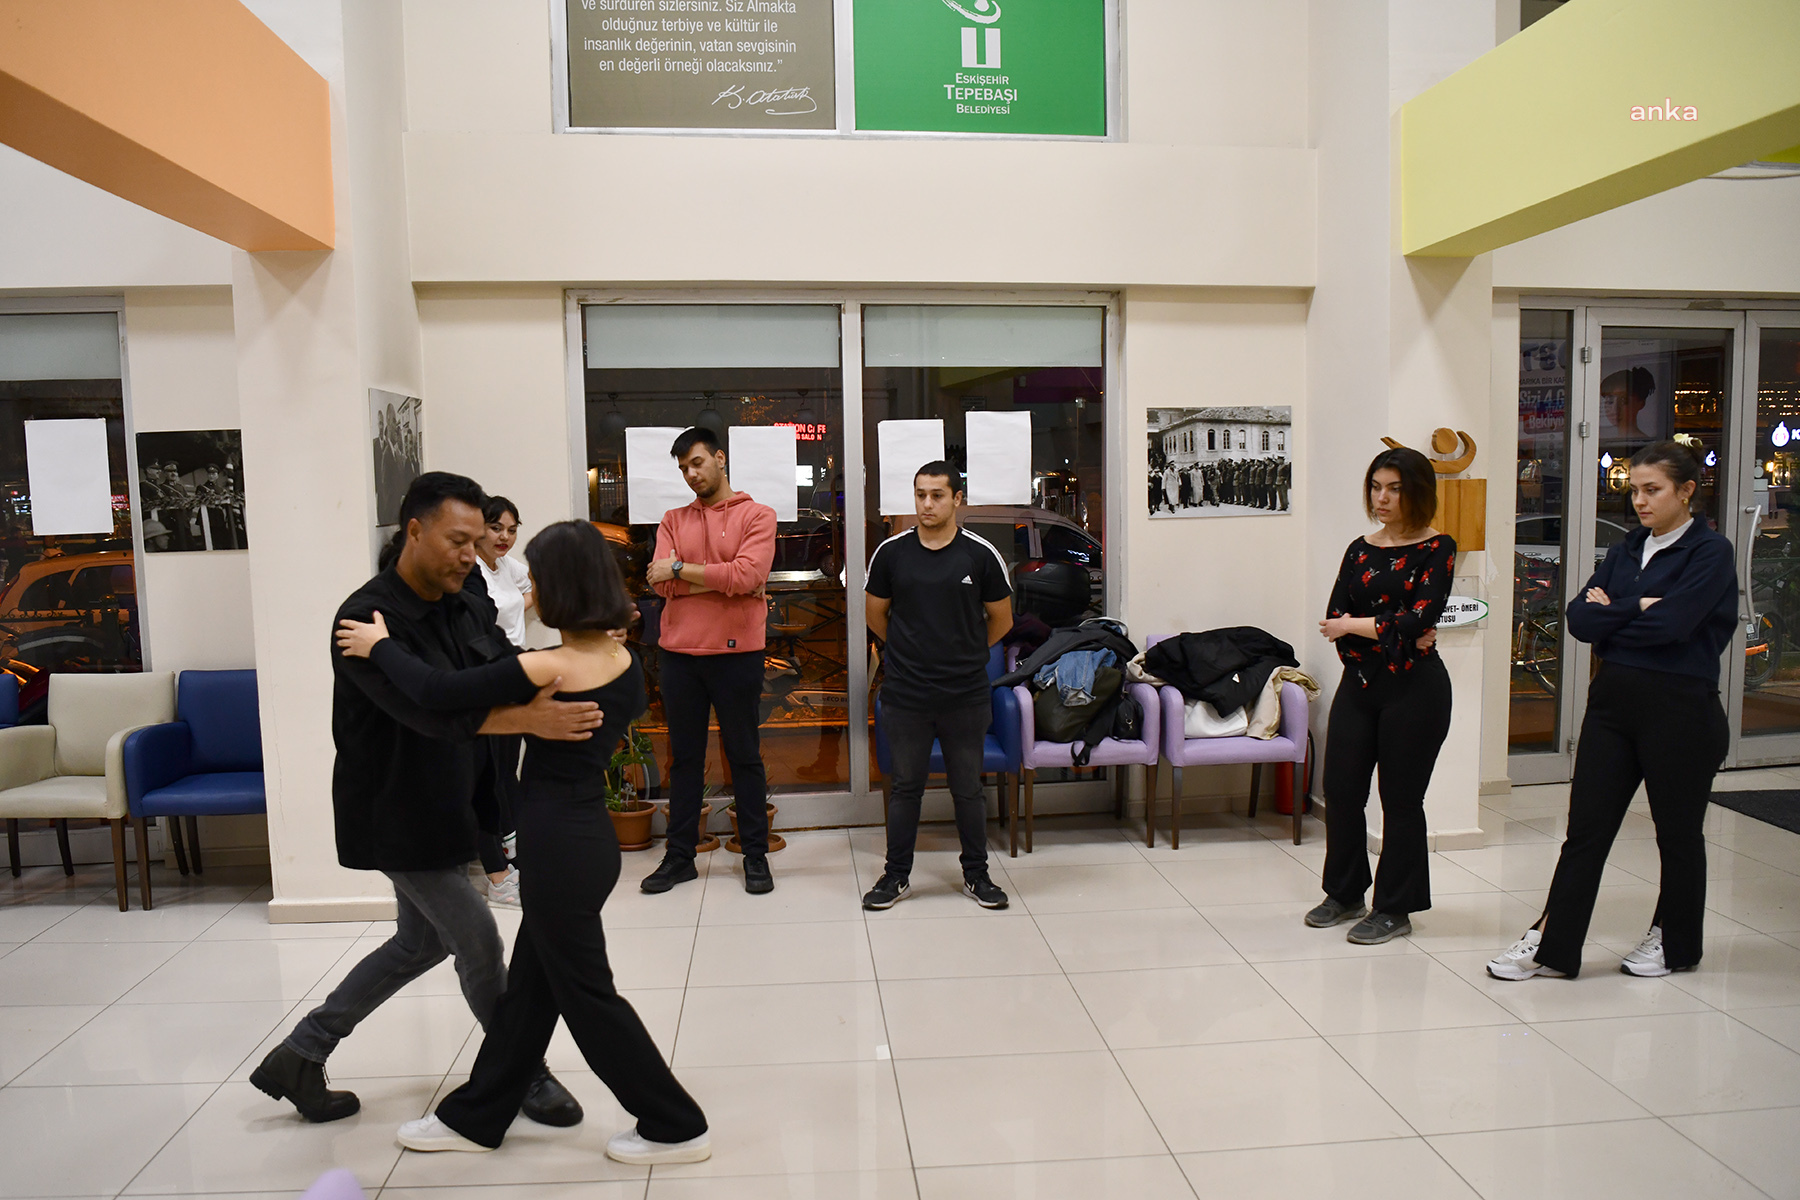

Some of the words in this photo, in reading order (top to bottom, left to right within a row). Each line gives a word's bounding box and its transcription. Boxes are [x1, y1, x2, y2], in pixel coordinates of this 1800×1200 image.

[582, 0, 596, 10] ve
[726, 0, 744, 12] Siz
[747, 0, 796, 13] Almakta
[602, 17, 658, 34] olduğnuz
[661, 18, 704, 35] terbiye
[707, 20, 721, 32] ve
[725, 18, 760, 32] kültür
[764, 19, 778, 32] ile
[584, 37, 632, 51] insanlık
[635, 38, 697, 55] değerinin,
[700, 40, 733, 52] vatan
[736, 40, 797, 55] sevgisinin
[600, 60, 615, 71] en
[618, 57, 660, 74] değerli
[664, 58, 703, 75] örneği
[955, 72, 1009, 86] ESKİŞEHİR
[943, 84, 1018, 104] TEPEBAŞI
[956, 103, 1010, 115] BELEDİYESİ
[1519, 390, 1541, 408] Sizi
[1461, 603, 1478, 612] ÖNERİ
[1437, 615, 1456, 623] TUSU
